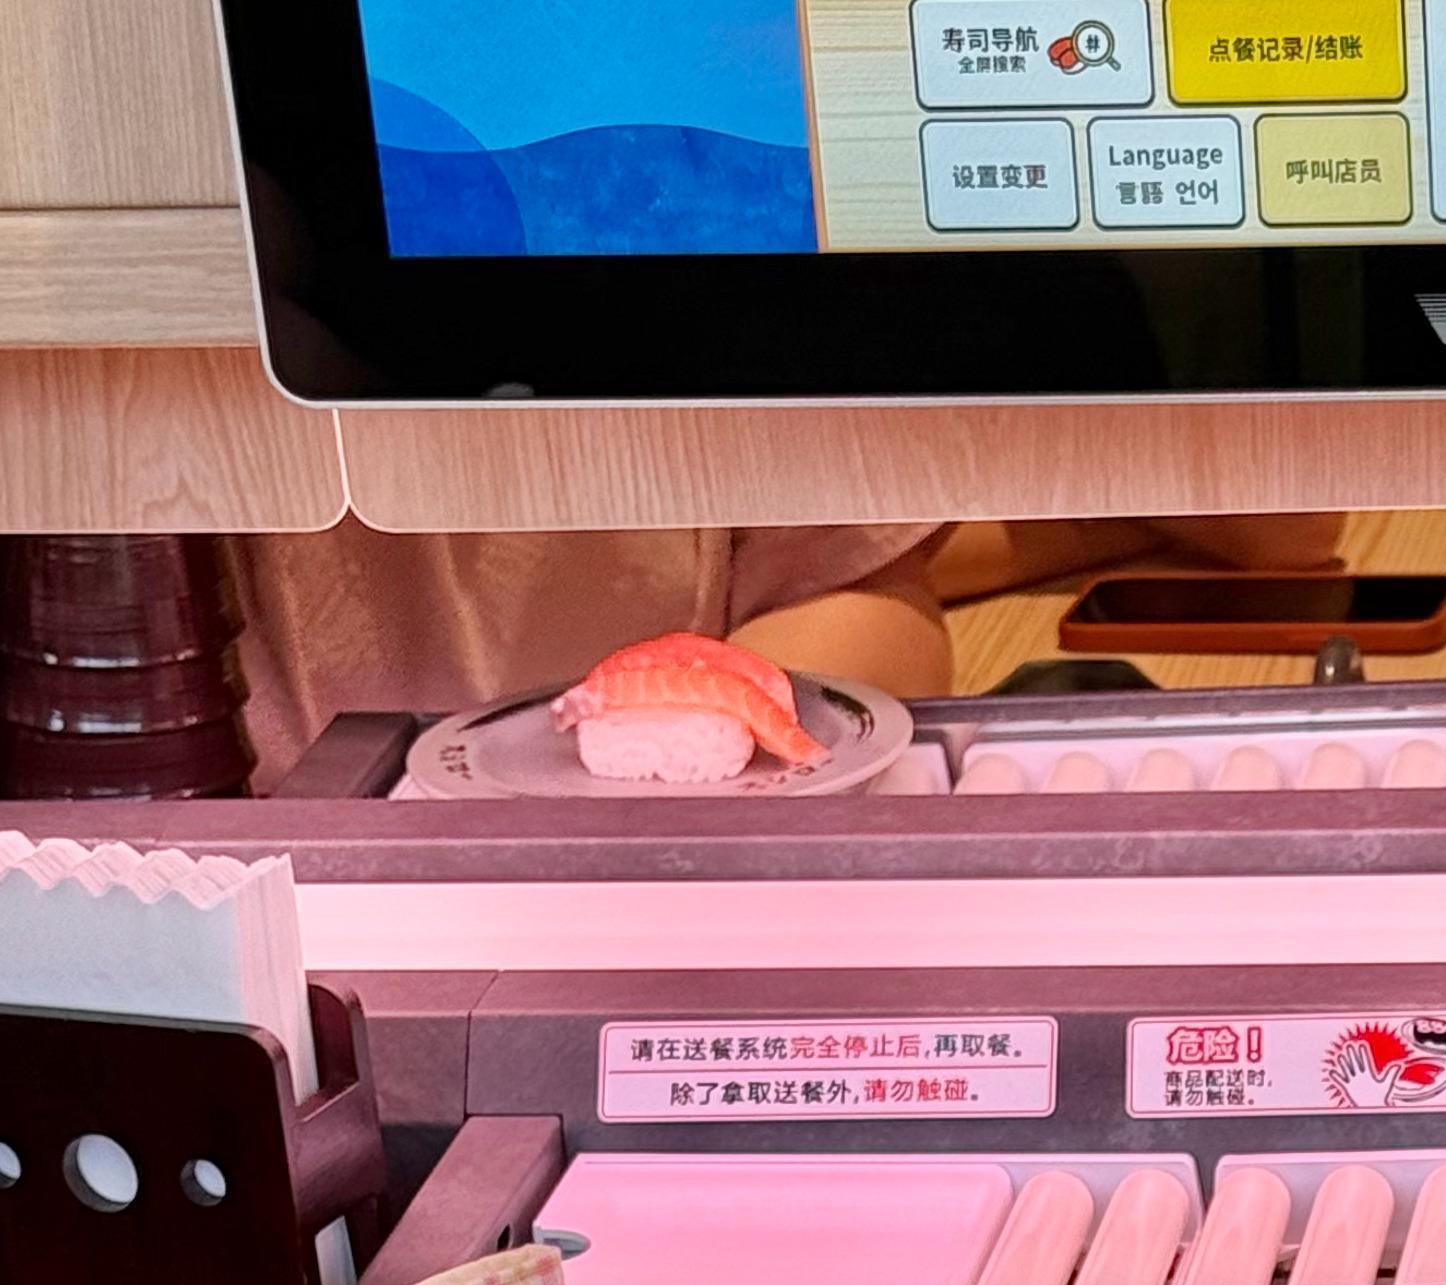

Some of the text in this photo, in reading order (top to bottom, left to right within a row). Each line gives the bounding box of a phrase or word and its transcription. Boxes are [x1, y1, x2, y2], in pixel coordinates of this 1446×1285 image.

[942, 27, 1040, 53] 寿司导航
[1208, 35, 1363, 63] 点餐记录/结账
[1109, 144, 1223, 170] Language
[952, 164, 1049, 189] 设置变更
[1286, 158, 1383, 185] 呼叫店员
[1165, 1025, 1263, 1064] 危险！
